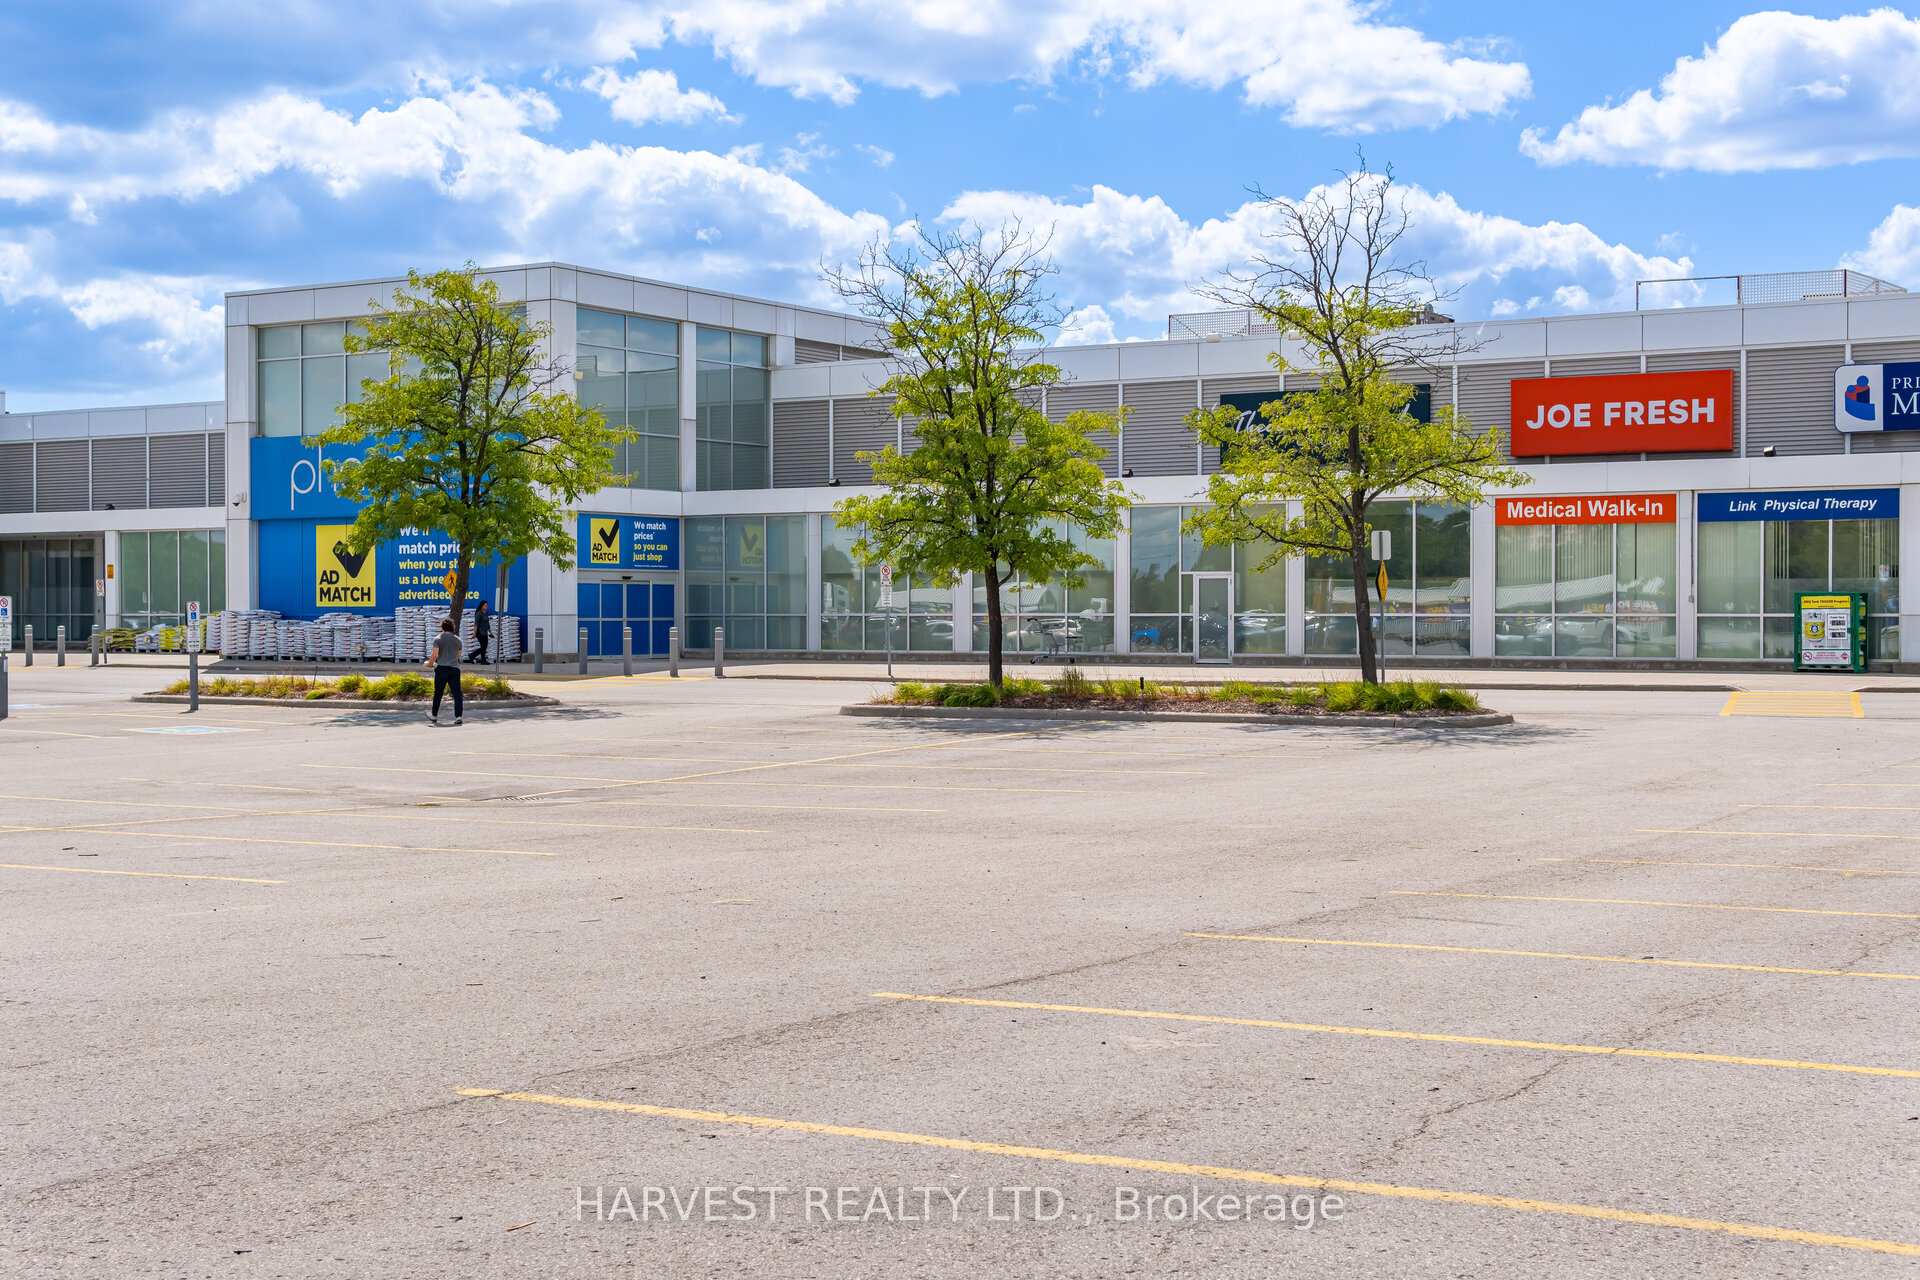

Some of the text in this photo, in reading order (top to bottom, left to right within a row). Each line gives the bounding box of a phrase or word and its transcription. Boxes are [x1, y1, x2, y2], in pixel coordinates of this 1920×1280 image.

[1526, 398, 1715, 429] JOE FRESH
[1507, 498, 1663, 519] Medical Walk-In
[1729, 497, 1877, 513] Link Physical Therapy
[634, 521, 667, 530] We match
[398, 541, 437, 555] match
[592, 543, 603, 552] AD
[634, 543, 668, 552] so you can
[592, 552, 618, 562] MATCH
[633, 552, 663, 563] just shop
[398, 558, 476, 571] when you shw
[319, 569, 340, 585] AD
[398, 574, 445, 585] us a lowe
[319, 586, 371, 602] MATCH
